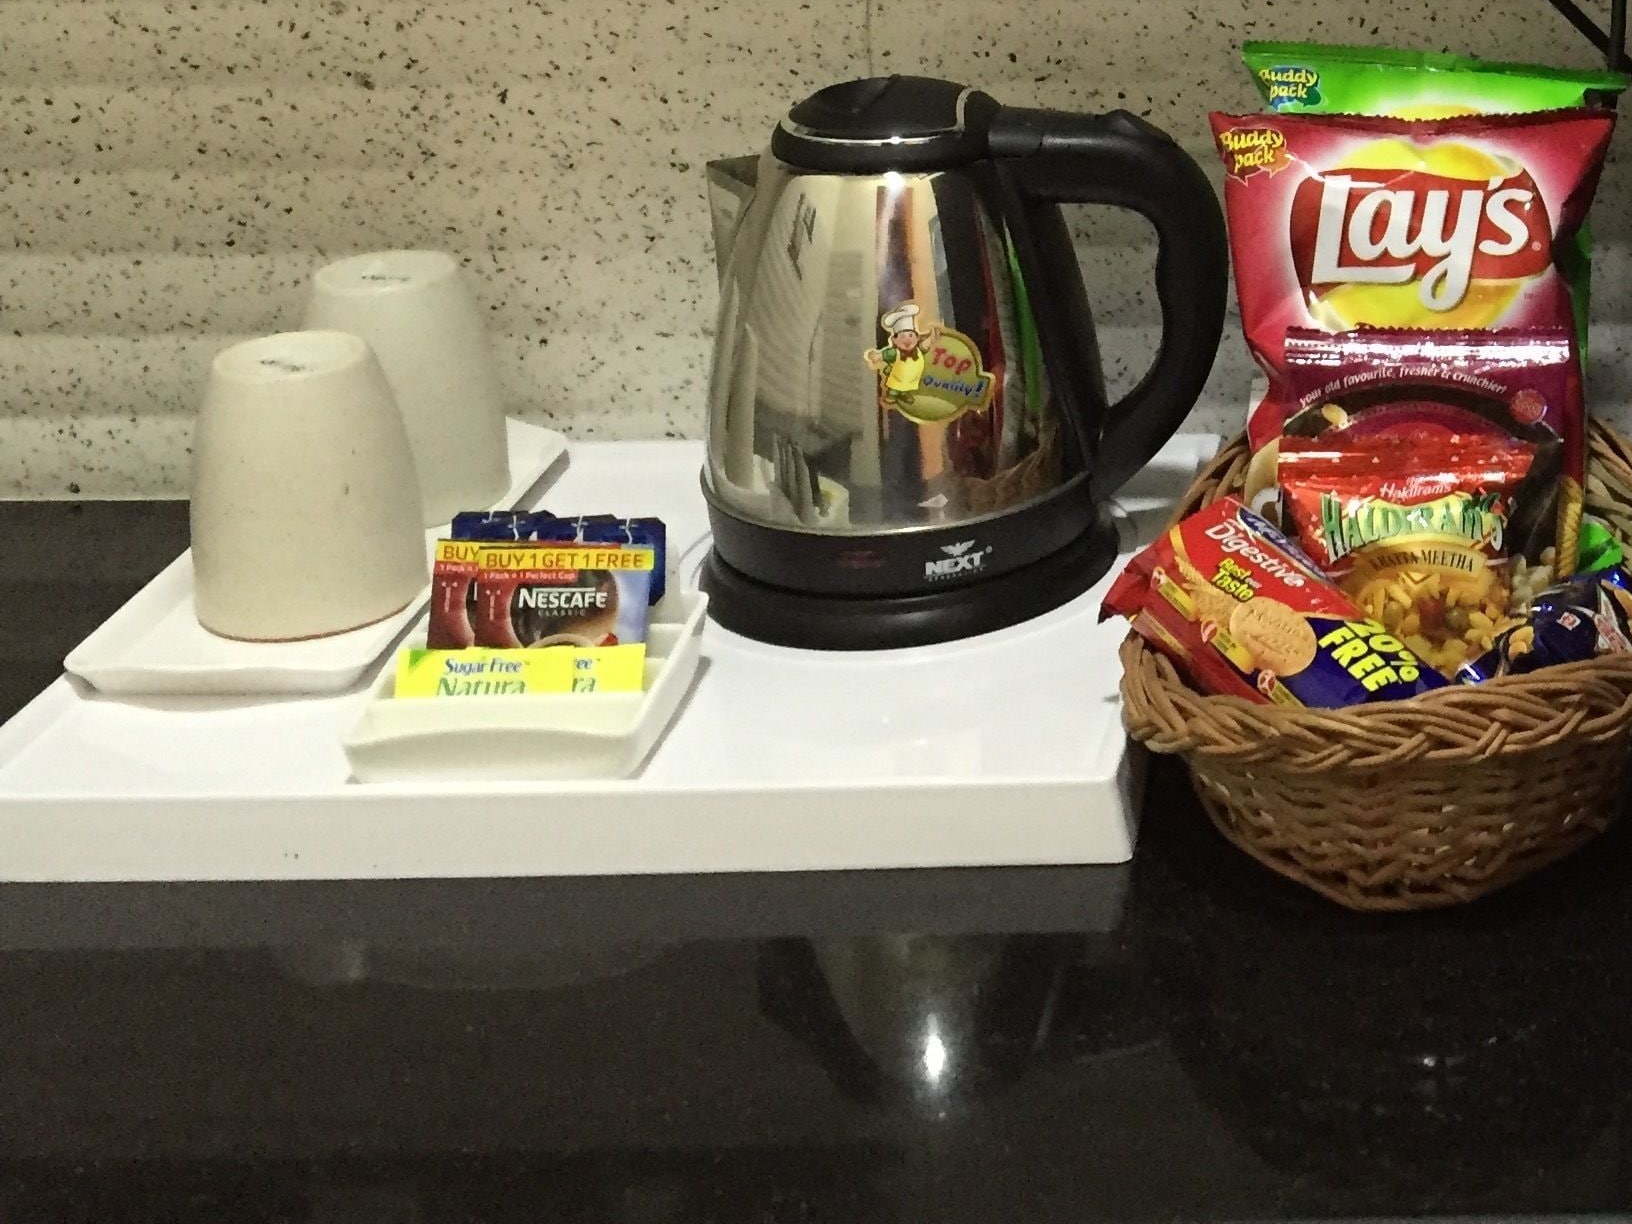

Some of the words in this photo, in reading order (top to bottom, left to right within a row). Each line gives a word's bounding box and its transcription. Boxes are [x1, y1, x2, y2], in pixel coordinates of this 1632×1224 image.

[1259, 69, 1318, 87] Buddy
[1269, 83, 1307, 102] pack
[1220, 130, 1284, 151] Buddy
[1234, 145, 1275, 174] pack
[1311, 175, 1536, 312] Lay's
[931, 346, 972, 375] Top
[1299, 388, 1322, 408] your
[1325, 380, 1341, 394] old
[1399, 366, 1440, 378] fresher
[1442, 367, 1451, 379] &
[443, 545, 479, 561] BUY
[486, 553, 524, 569] BUY
[529, 553, 537, 568] 1
[542, 553, 578, 569] GET
[583, 553, 591, 568] 1
[596, 553, 644, 569] FREE
[924, 551, 985, 576] NEXT
[1204, 522, 1306, 587] Digestive
[1421, 549, 1474, 572] MEETHA
[489, 572, 510, 580] Pack
[525, 572, 557, 580] Perfect
[1219, 558, 1252, 580] Best
[1211, 568, 1255, 601] Taste
[1317, 626, 1399, 692] FREE
[1344, 618, 1420, 683] 20%
[445, 657, 485, 675] Sugar
[489, 657, 522, 673] Free
[437, 677, 526, 696] Natura
